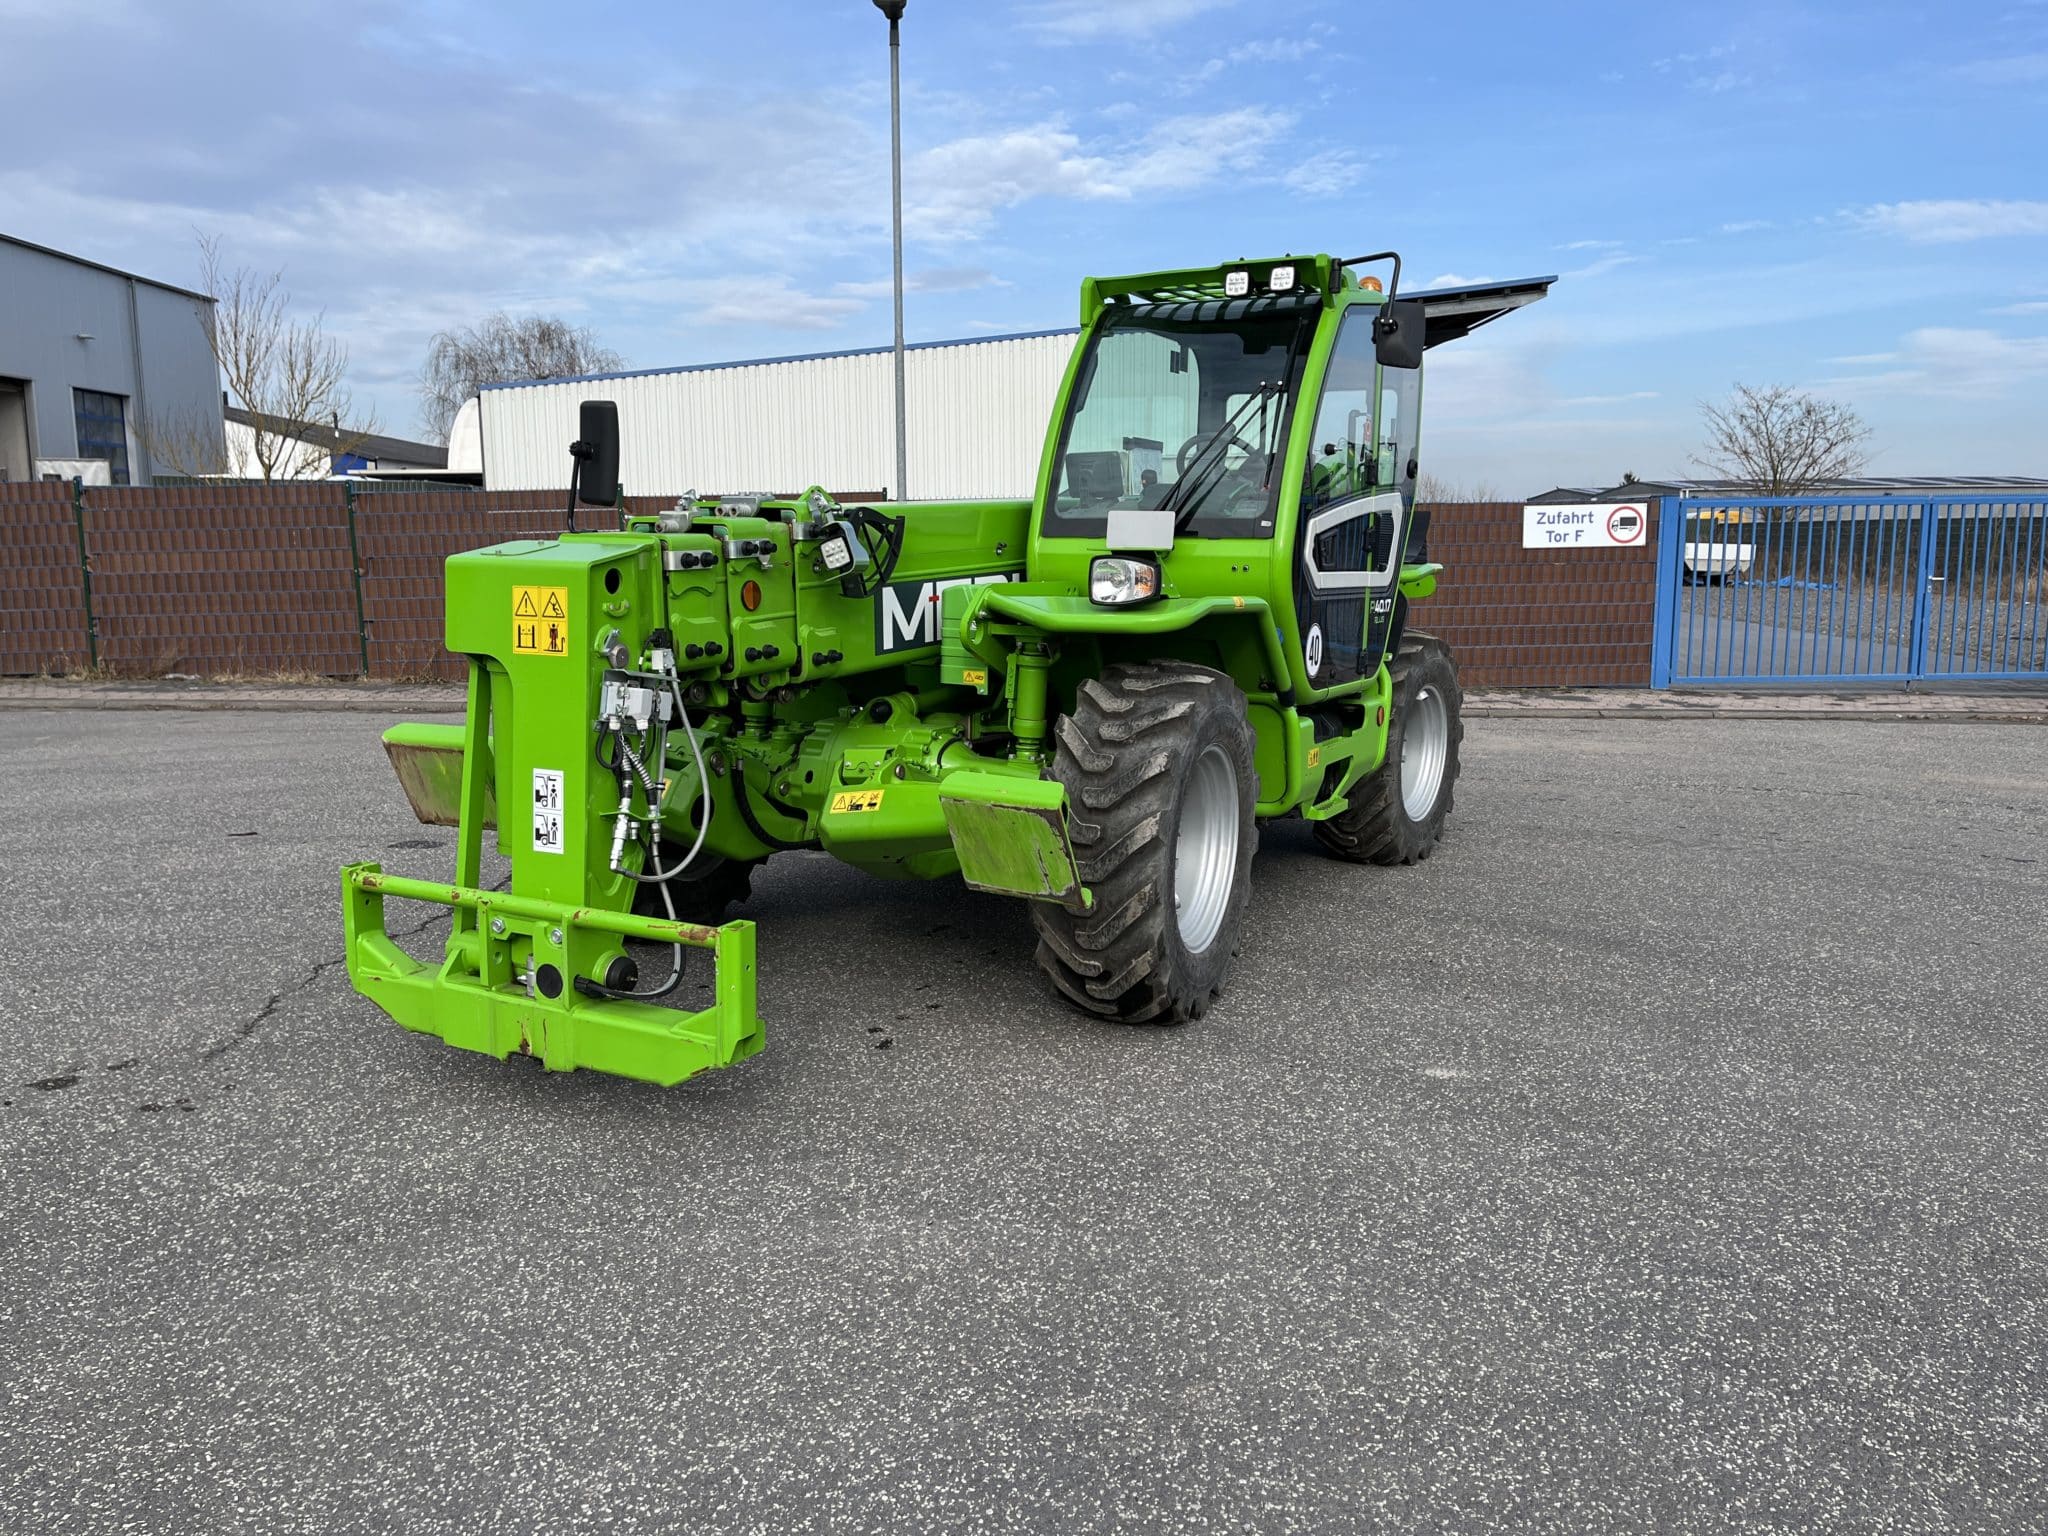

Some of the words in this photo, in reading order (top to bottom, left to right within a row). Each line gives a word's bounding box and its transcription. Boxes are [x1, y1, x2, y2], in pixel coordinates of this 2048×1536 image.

[1536, 511, 1594, 525] Zufahrt
[1546, 530, 1570, 543] Tor
[1575, 529, 1585, 542] F
[1308, 634, 1320, 667] 40
